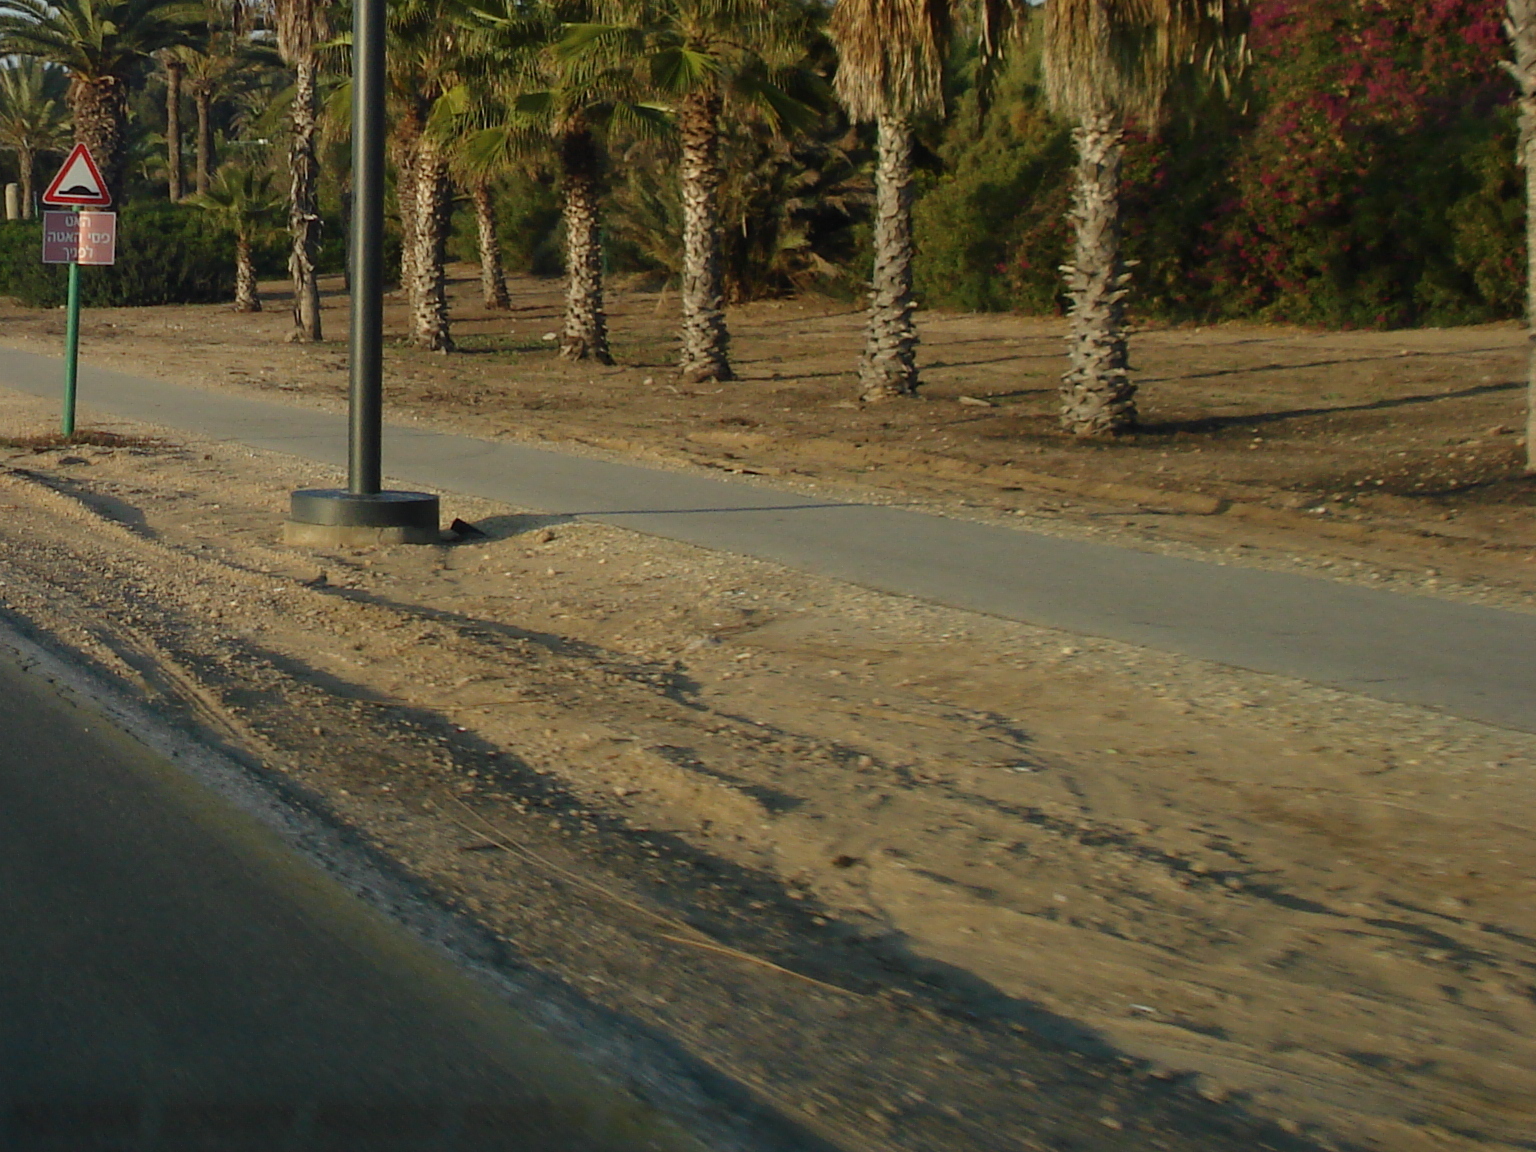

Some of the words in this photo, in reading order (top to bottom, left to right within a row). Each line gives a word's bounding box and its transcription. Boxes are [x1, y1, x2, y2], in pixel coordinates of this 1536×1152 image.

[65, 216, 91, 227] האט
[47, 231, 82, 243] האטה
[88, 232, 111, 244] פסי
[63, 245, 93, 261] לפניך
